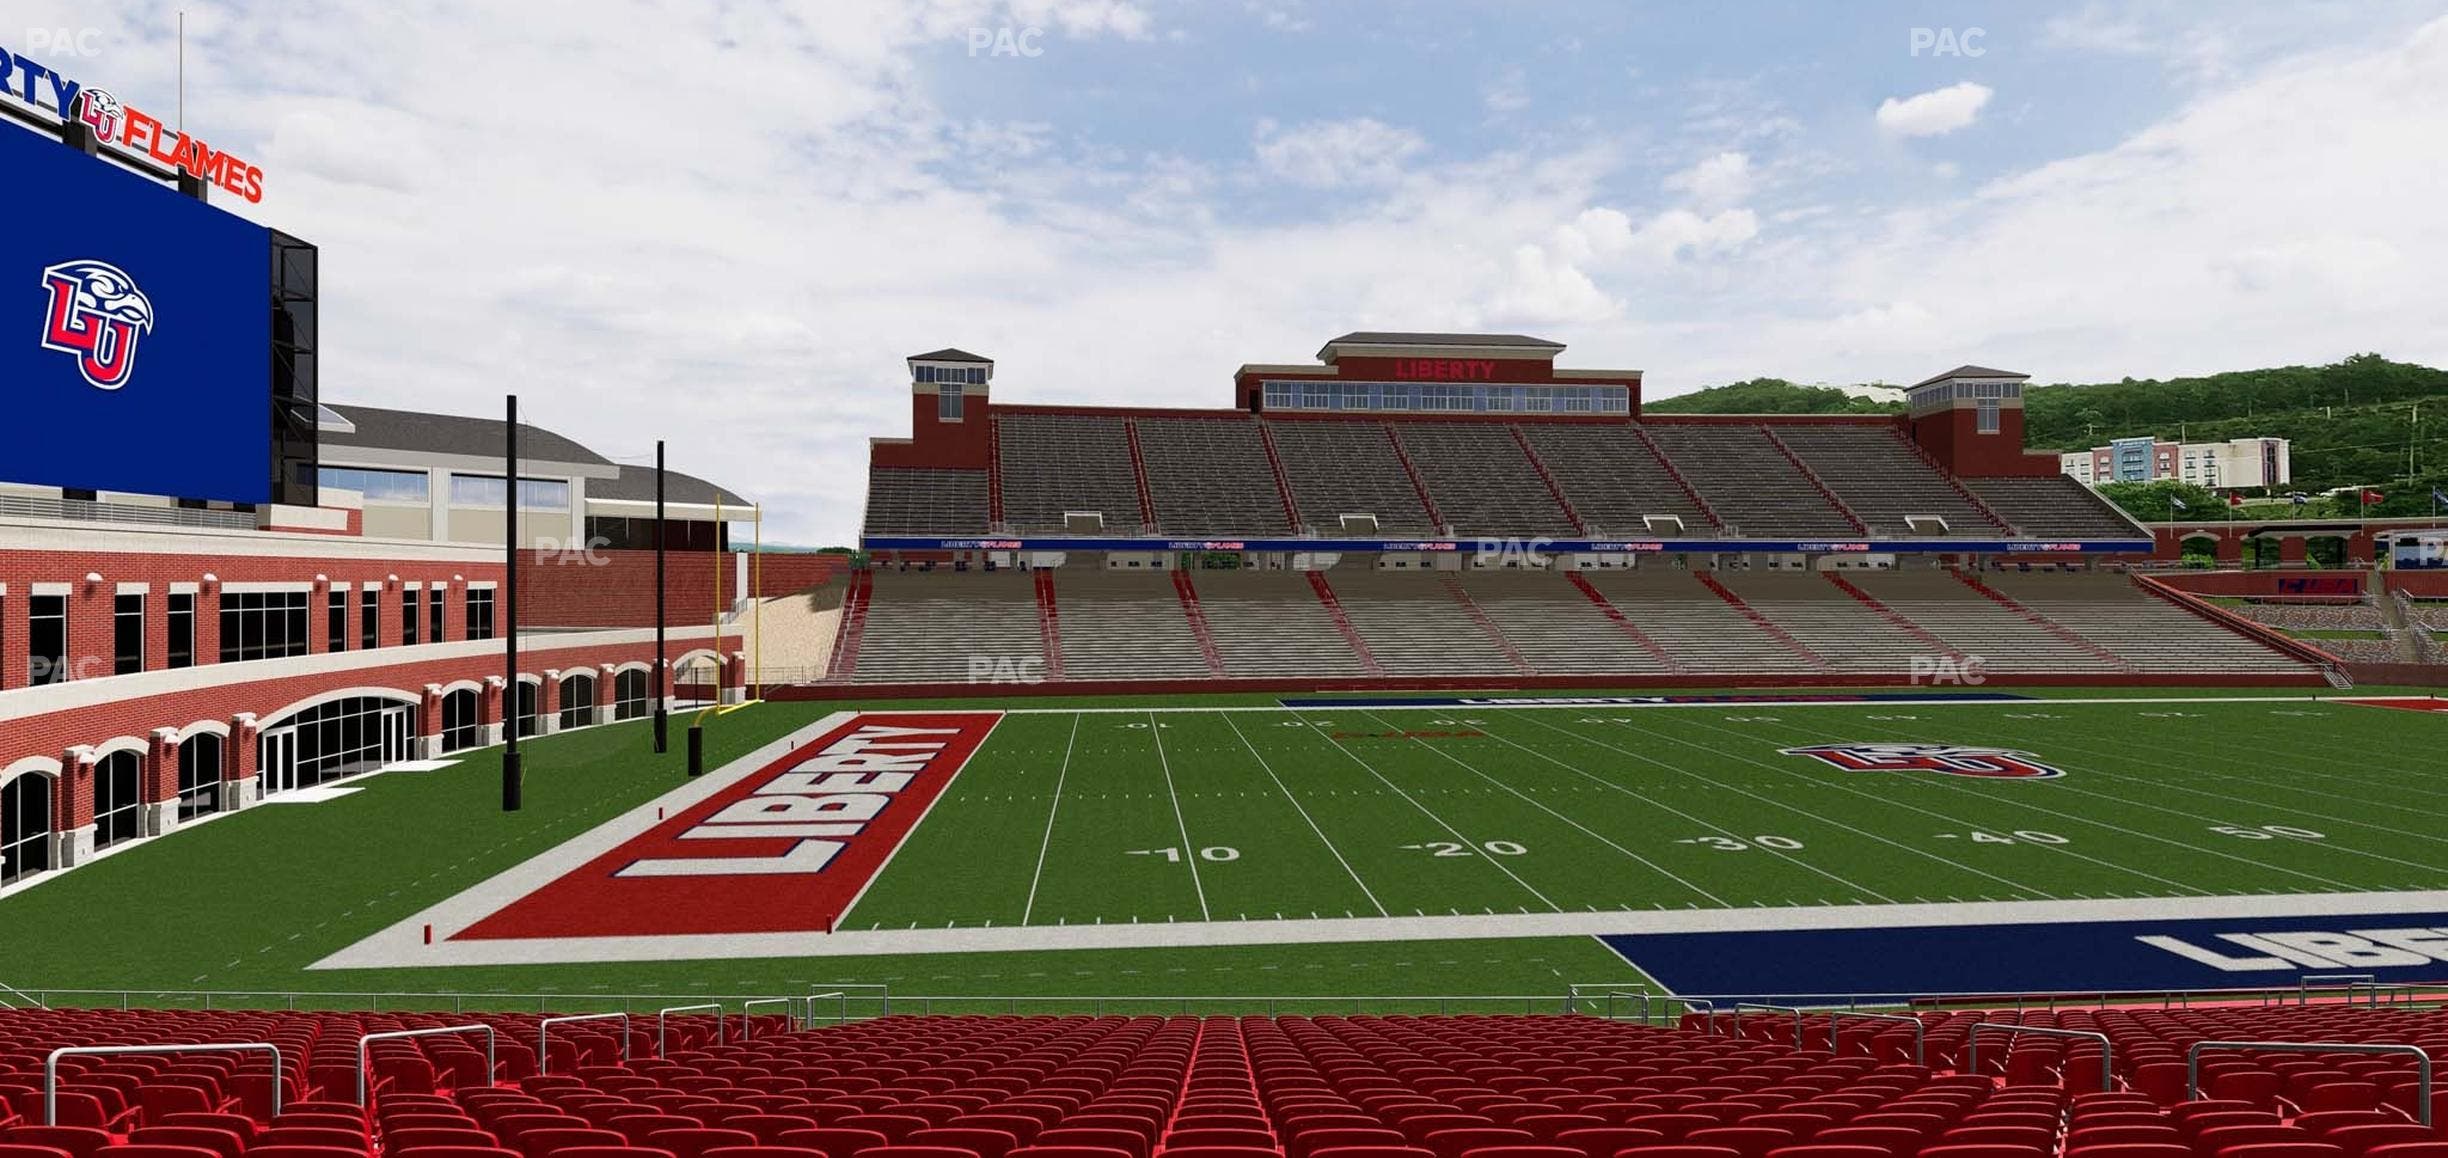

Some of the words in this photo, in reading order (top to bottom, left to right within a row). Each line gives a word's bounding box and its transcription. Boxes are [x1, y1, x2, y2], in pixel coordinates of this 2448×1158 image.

[122, 104, 263, 204] FLAMES
[1394, 358, 1495, 379] LIBERTY
[611, 725, 963, 878] LIBERTY
[1968, 829, 2069, 846] 40
[2208, 825, 2326, 841] 50
[1426, 841, 1528, 858] 20
[1697, 835, 1805, 851] 30
[1153, 846, 1240, 862] 10
[2134, 926, 2448, 972] LIBE
